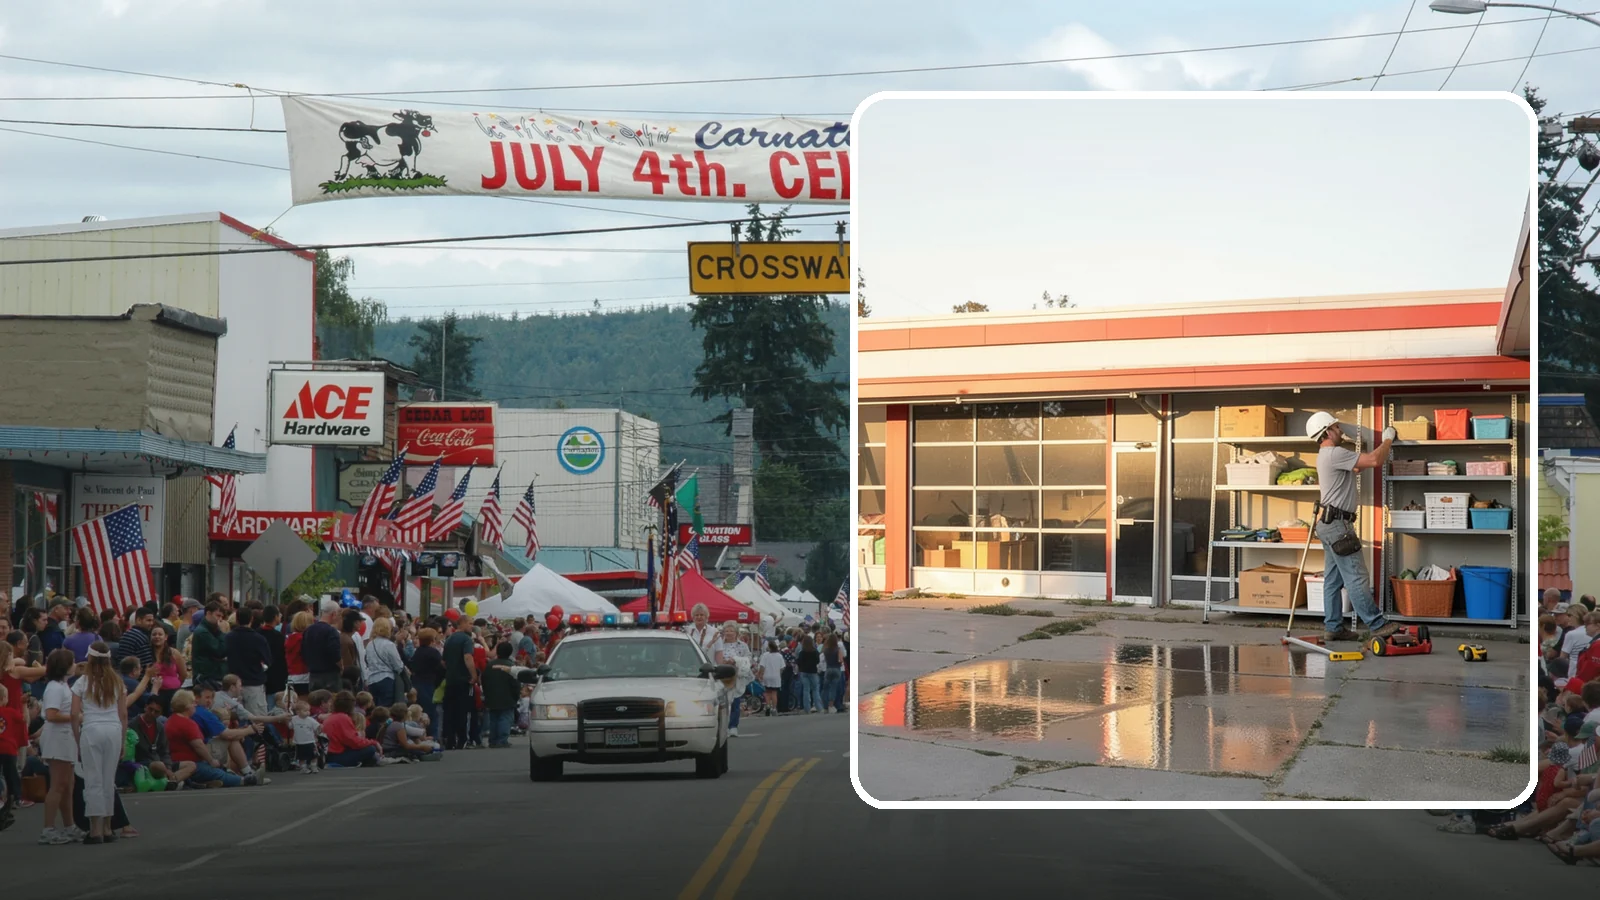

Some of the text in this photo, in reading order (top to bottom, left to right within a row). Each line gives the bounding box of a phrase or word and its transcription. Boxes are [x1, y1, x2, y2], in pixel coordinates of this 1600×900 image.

[480, 140, 604, 192] JULY
[632, 150, 745, 198] 4th.
[696, 254, 850, 280] CROSSWA
[282, 380, 373, 420] ACE
[405, 409, 452, 421] CEDAR
[283, 421, 370, 436] Hardware
[416, 428, 477, 447] Coca-Cola
[353, 466, 386, 481] Simpl
[83, 485, 155, 495] St. Vincent de Paul
[688, 526, 741, 535] CRNATION
[699, 535, 730, 544] GLASS
